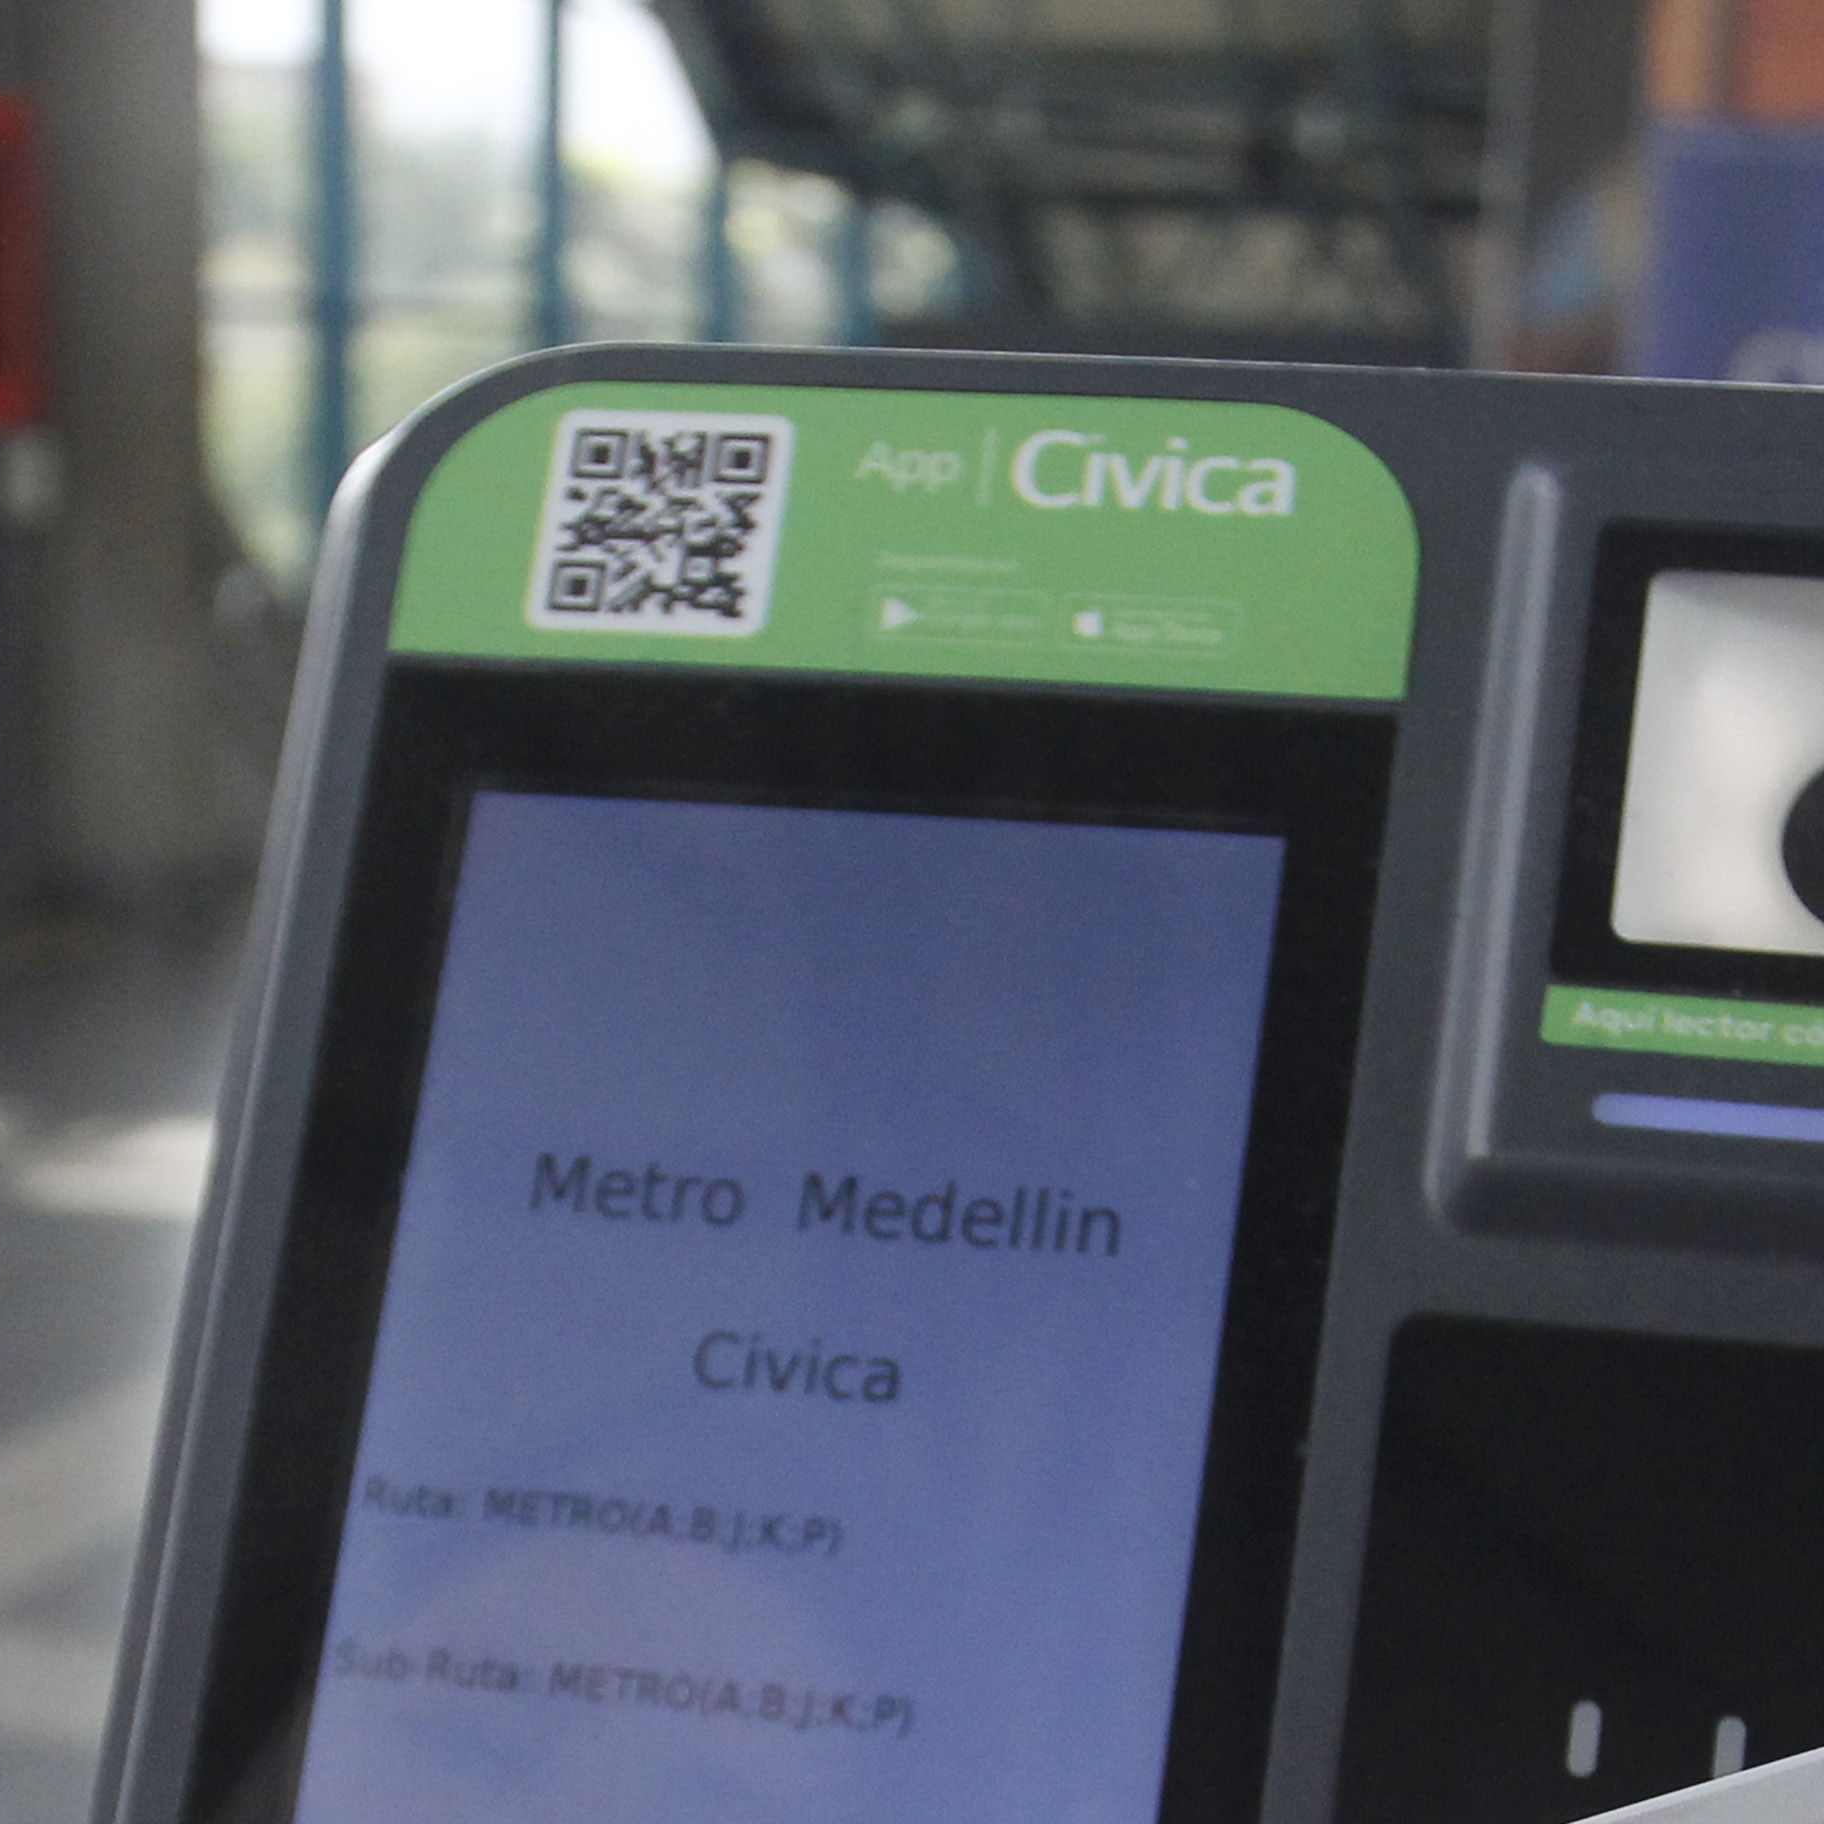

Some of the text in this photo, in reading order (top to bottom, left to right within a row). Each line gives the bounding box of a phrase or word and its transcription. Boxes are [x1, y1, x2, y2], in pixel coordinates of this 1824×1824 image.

[854, 440, 964, 493] App
[1663, 1006, 1772, 1043] lector
[529, 1151, 746, 1228] Metro
